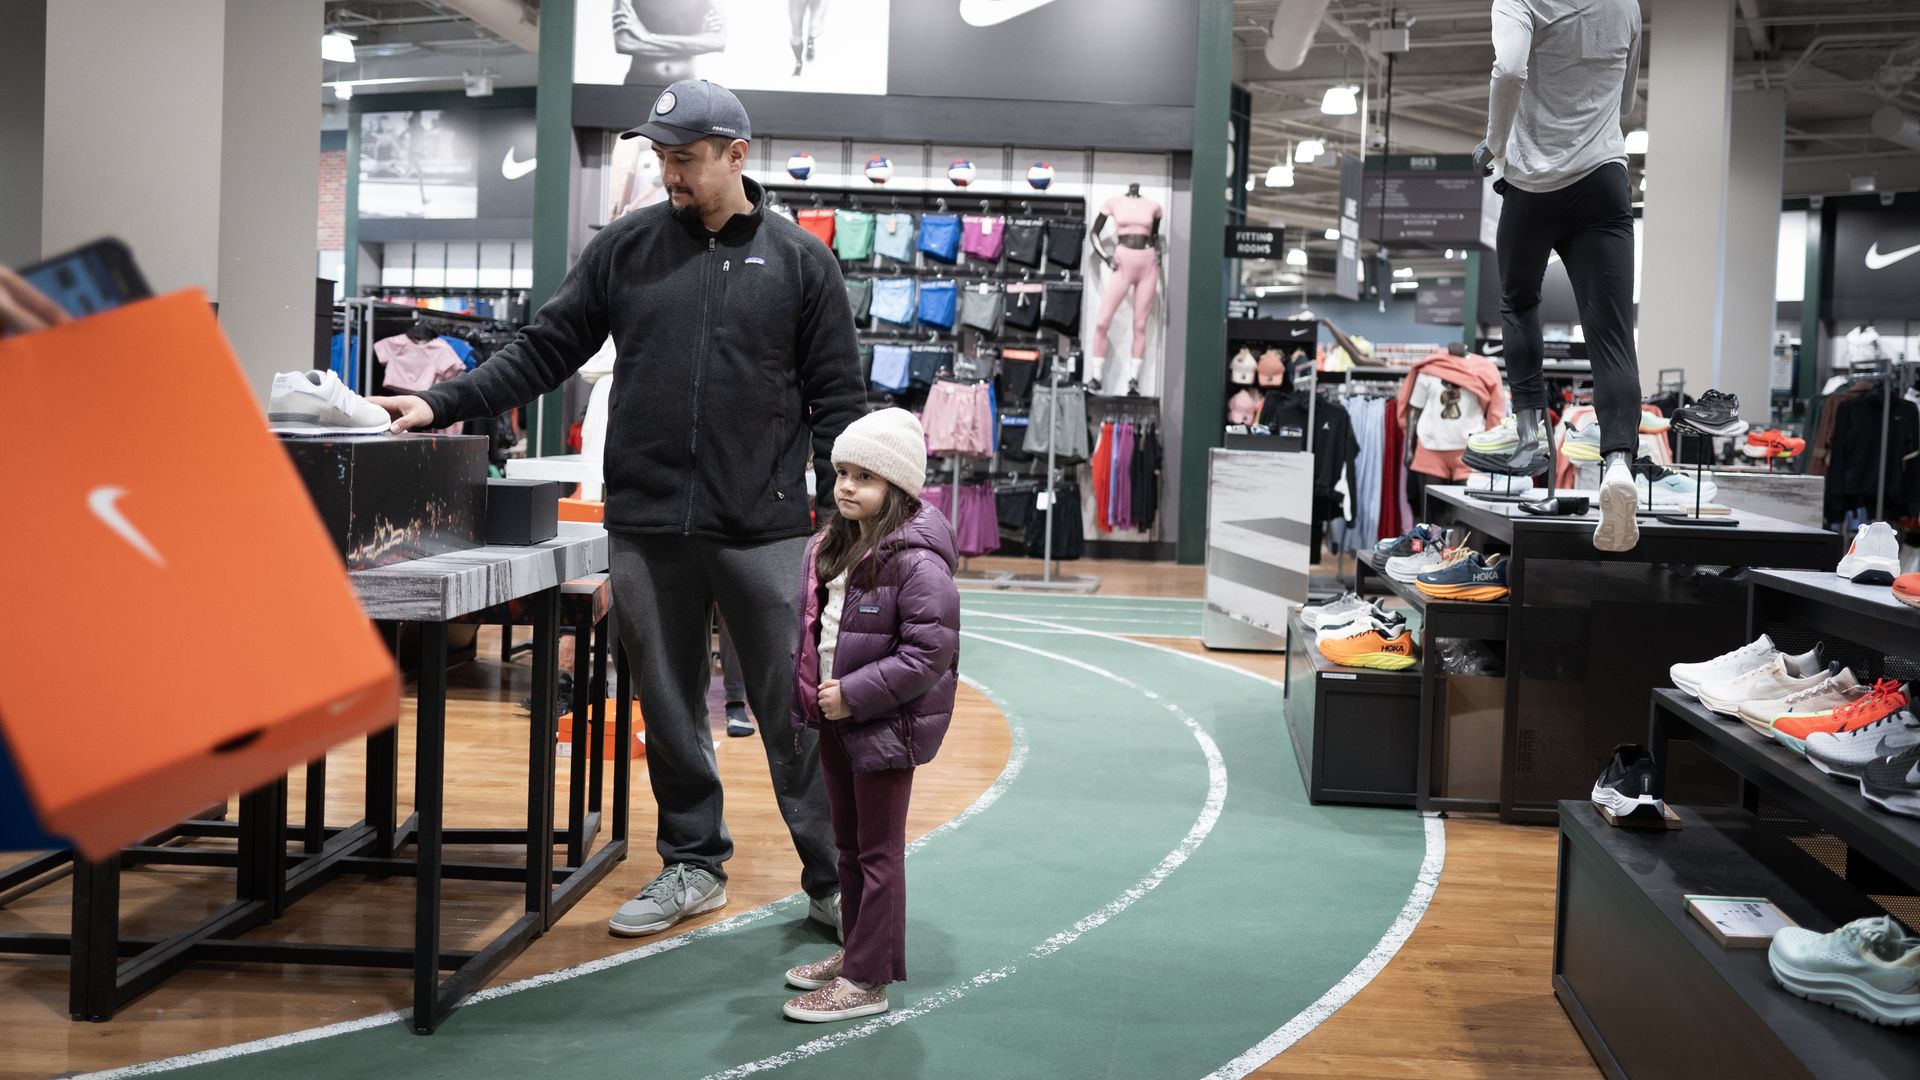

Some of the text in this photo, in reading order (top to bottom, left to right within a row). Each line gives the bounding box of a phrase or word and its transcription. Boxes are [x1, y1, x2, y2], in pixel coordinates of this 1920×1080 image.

[1235, 231, 1274, 242] FITTING
[1237, 243, 1272, 254] ROOMS
[1472, 571, 1499, 582] HOKA
